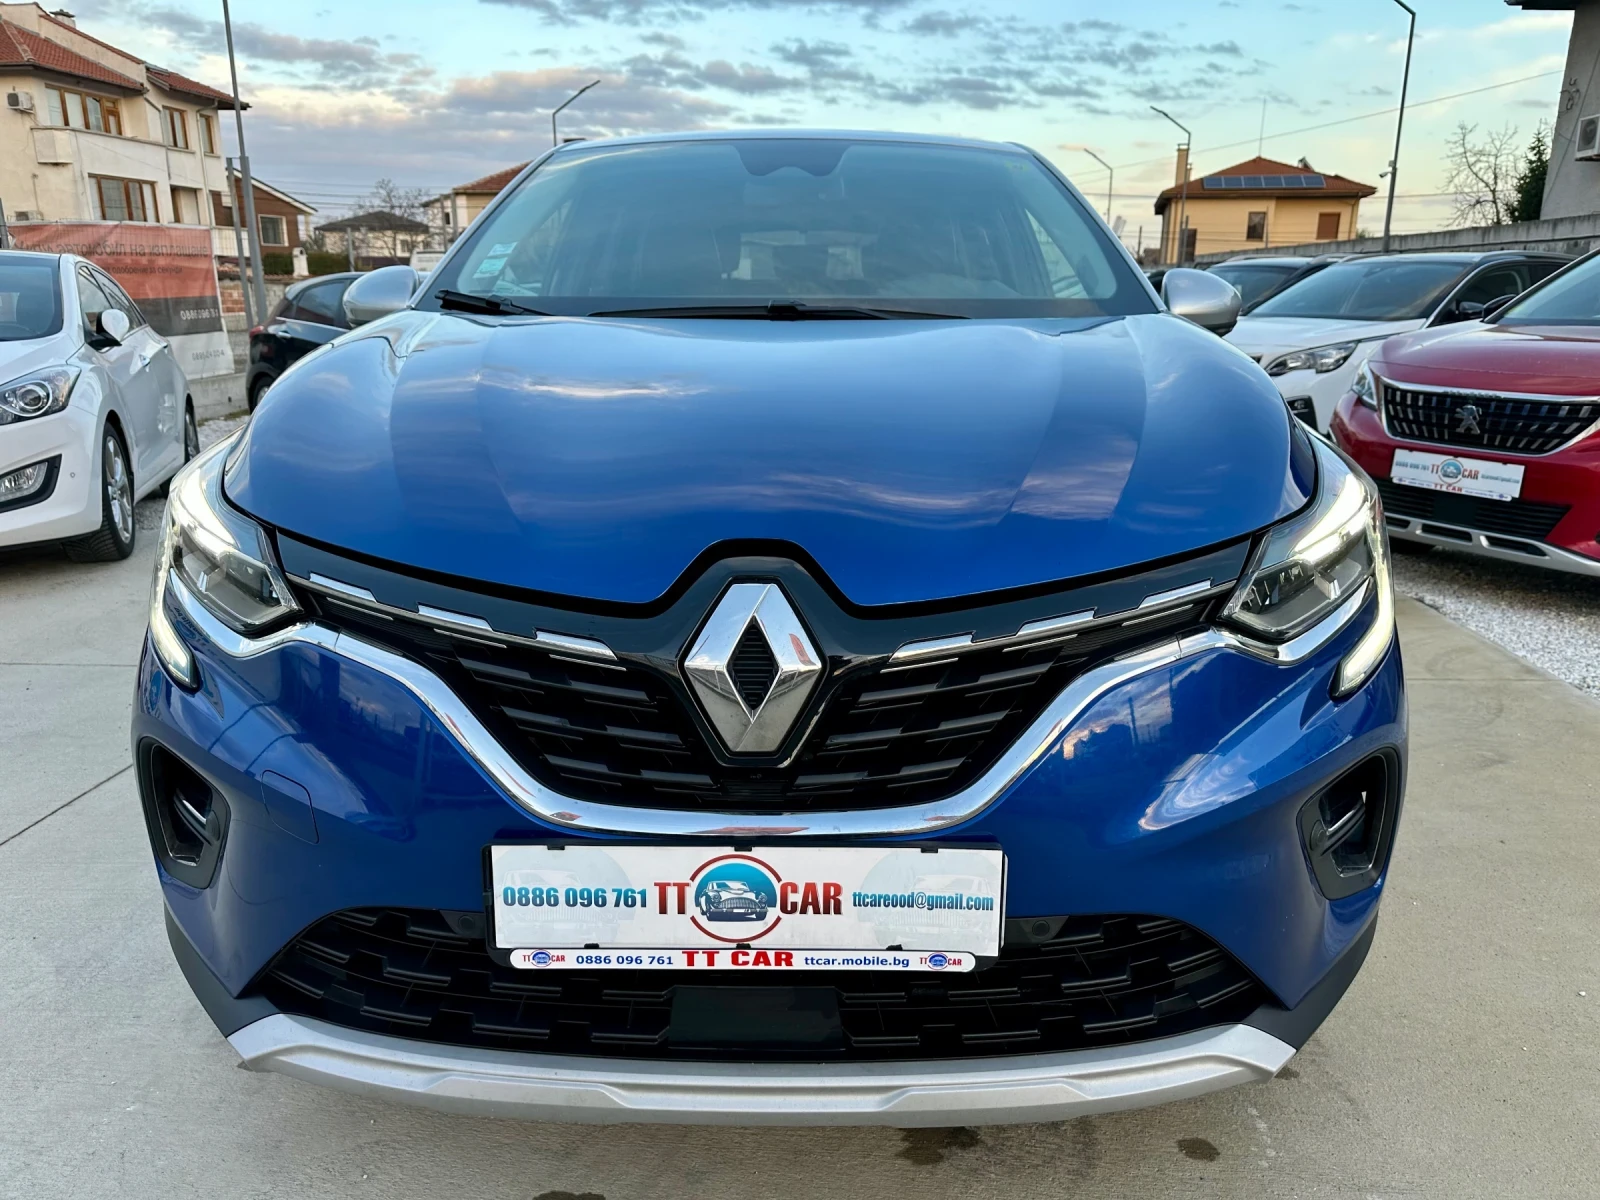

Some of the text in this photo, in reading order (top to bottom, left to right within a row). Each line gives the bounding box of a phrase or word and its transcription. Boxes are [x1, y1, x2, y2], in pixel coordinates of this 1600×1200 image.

[57, 240, 126, 256] автомобил
[130, 243, 146, 256] на
[1430, 464, 1440, 474] TT
[1462, 468, 1480, 480] CAR
[1446, 484, 1462, 493] CAR
[503, 882, 994, 915] 0886 096 761 TT CAR ttcareood@gmail.com
[522, 950, 962, 968] TT CAR 0886 096 761 TT CAR ttcar.mobile.bg TT CAR
